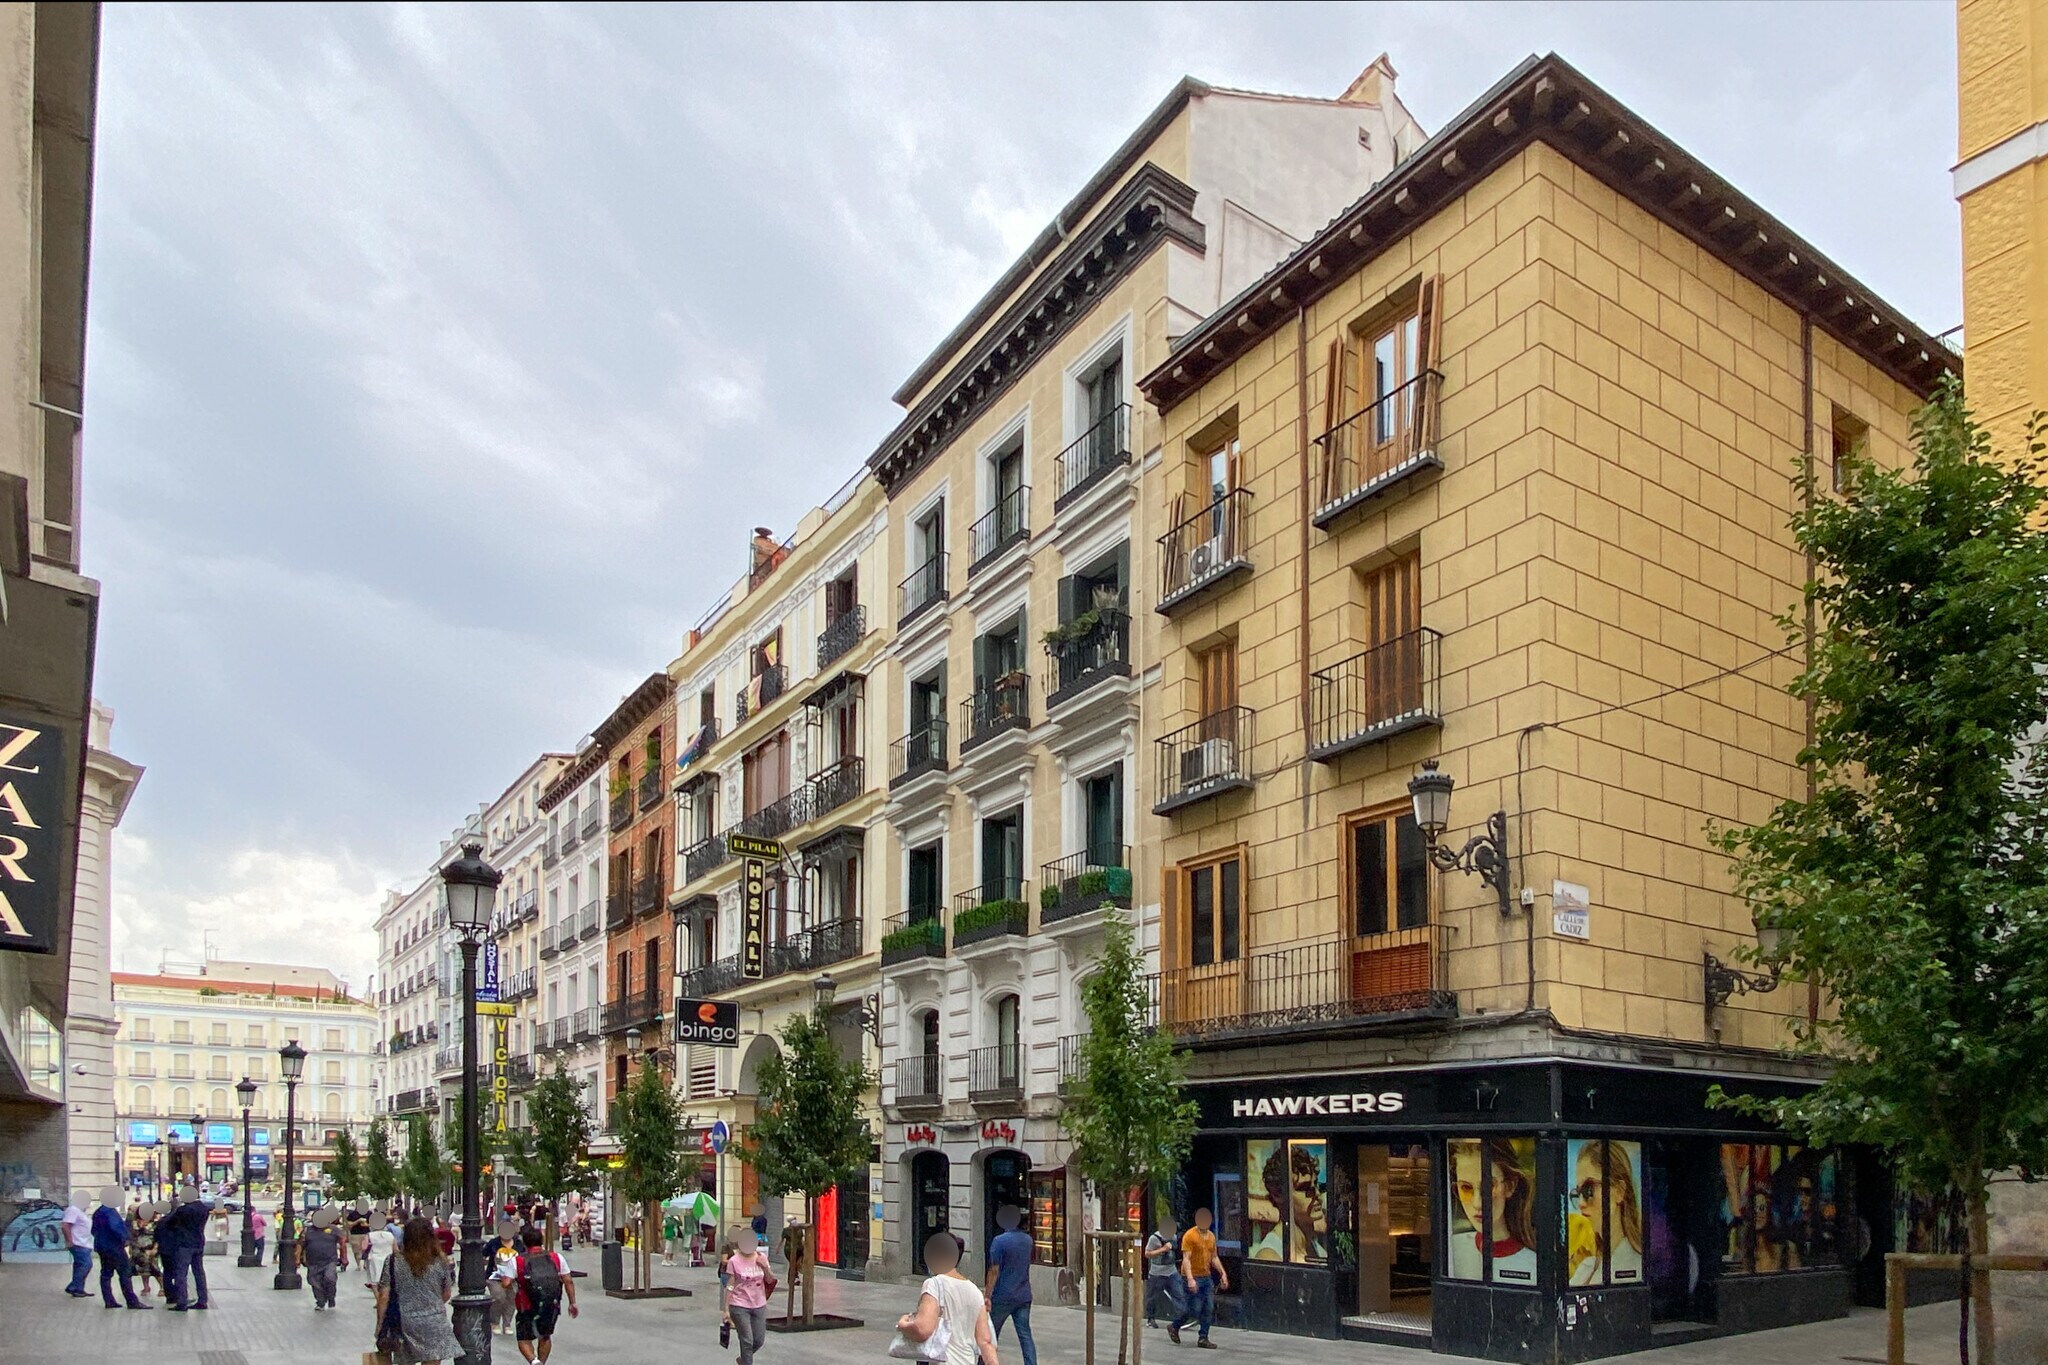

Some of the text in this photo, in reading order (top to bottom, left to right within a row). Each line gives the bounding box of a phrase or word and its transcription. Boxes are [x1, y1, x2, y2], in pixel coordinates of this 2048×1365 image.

[0, 723, 42, 937] ZARA
[733, 840, 778, 854] EL PILAR
[747, 864, 762, 960] HOSTAL
[486, 944, 498, 983] HOSTAL
[680, 1020, 736, 1042] bingo
[495, 1018, 508, 1132] VICTORIA
[1232, 1092, 1404, 1118] HAWKERS
